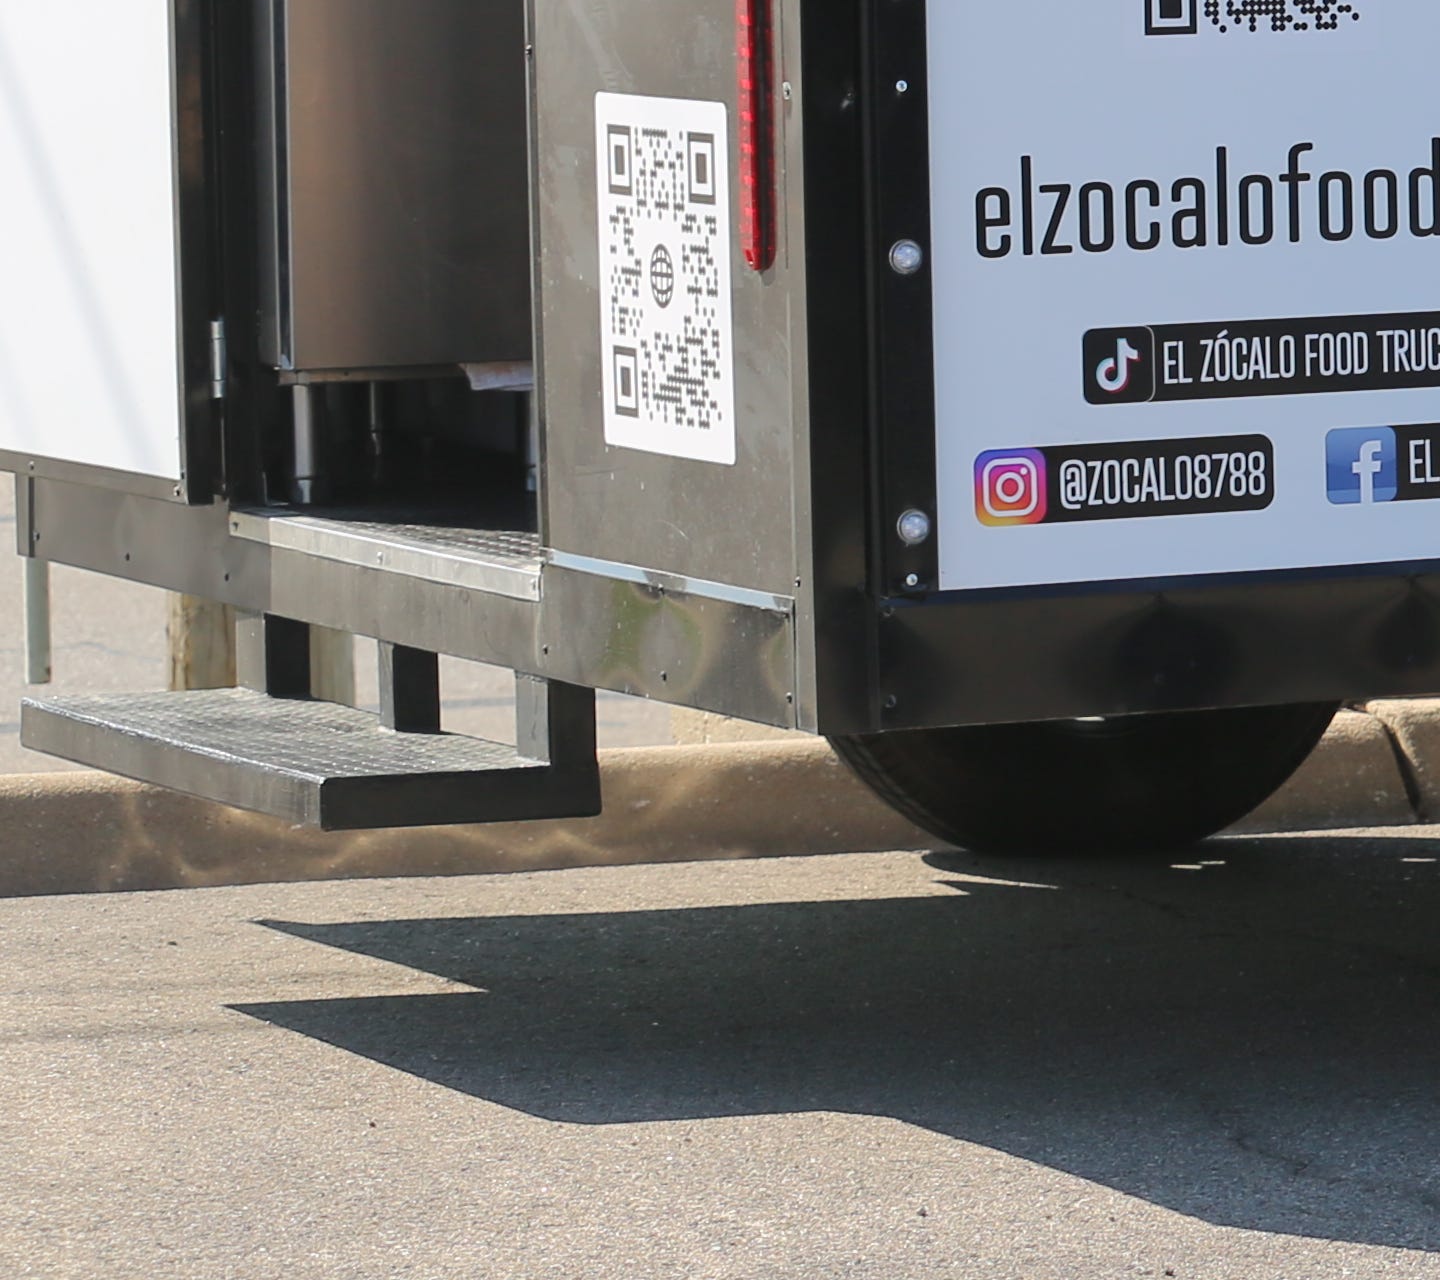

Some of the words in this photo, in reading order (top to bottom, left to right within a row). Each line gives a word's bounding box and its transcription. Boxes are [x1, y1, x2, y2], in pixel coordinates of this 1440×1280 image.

[1163, 341, 1192, 385] EL
[1200, 330, 1295, 381] ZÓCALO
[1304, 332, 1368, 377] FOOD
